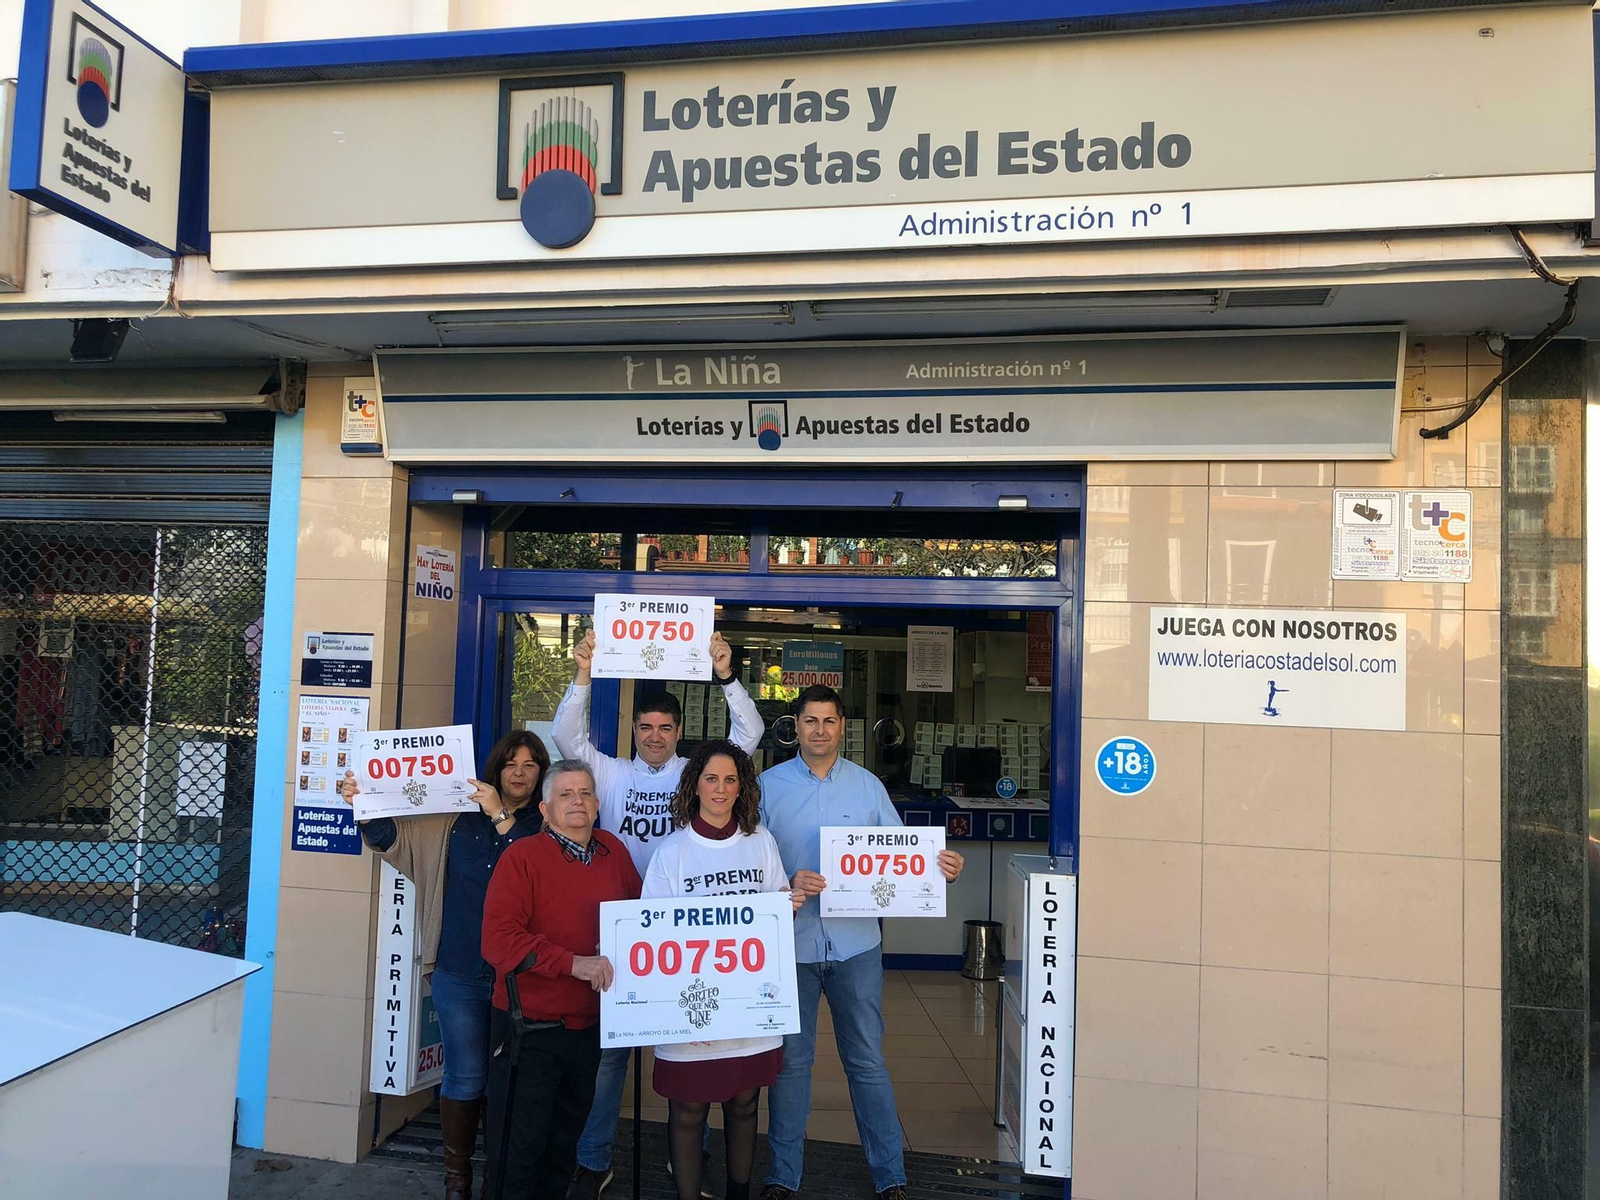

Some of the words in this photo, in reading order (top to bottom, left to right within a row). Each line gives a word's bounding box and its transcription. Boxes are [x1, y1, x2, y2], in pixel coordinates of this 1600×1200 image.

[642, 79, 850, 132] Loterías
[867, 86, 897, 131] y
[63, 117, 121, 163] Loterías
[123, 155, 132, 173] y
[62, 142, 127, 190] Apuestas
[131, 179, 151, 203] del
[642, 141, 881, 202] Apuestas
[898, 130, 979, 181] del
[998, 122, 1192, 175] Estado
[61, 163, 111, 203] Estado
[899, 204, 1114, 237] Administración
[1131, 204, 1162, 227] nº
[1181, 202, 1192, 225] 1
[656, 358, 691, 386] La
[705, 354, 781, 384] Niña
[905, 360, 1044, 379] Administración
[1050, 360, 1072, 377] nº
[1079, 360, 1088, 376] 1
[636, 416, 724, 436] Loterías
[729, 419, 743, 440] y
[796, 414, 899, 439] Apuestas
[906, 412, 942, 434] del
[950, 412, 1030, 433] Estado
[416, 582, 454, 600] NIÑO
[640, 602, 689, 614] PREMIO
[612, 619, 694, 641] 00750
[1157, 617, 1226, 637] JUEGA
[1232, 618, 1275, 638] CON
[1283, 620, 1397, 641] NOSOTROS
[789, 650, 838, 659] EuroMillones
[1157, 648, 1397, 674] www.loteriacostadelsol.com
[393, 735, 445, 749] PREMIO
[368, 754, 454, 779] 00750
[1103, 751, 1142, 775] +18
[998, 783, 1013, 791] +18
[298, 810, 335, 821] Loterías
[337, 814, 343, 824] y
[298, 822, 340, 835] Apuestas
[342, 825, 357, 836] del
[297, 835, 328, 847] Estado
[868, 834, 918, 846] PREMIO
[840, 854, 925, 876] 00750
[704, 869, 764, 888] PREMIO
[391, 870, 404, 935] ERIA
[640, 909, 666, 928] 3er
[673, 906, 755, 927] PREMIO
[1041, 882, 1058, 1004] LOTERIA
[629, 937, 766, 977] 00750
[678, 987, 719, 1008] SORTEO
[689, 1003, 703, 1011] QUE
[384, 954, 402, 1088] PRIMITIVA
[1038, 1026, 1056, 1168] NACIONAL
